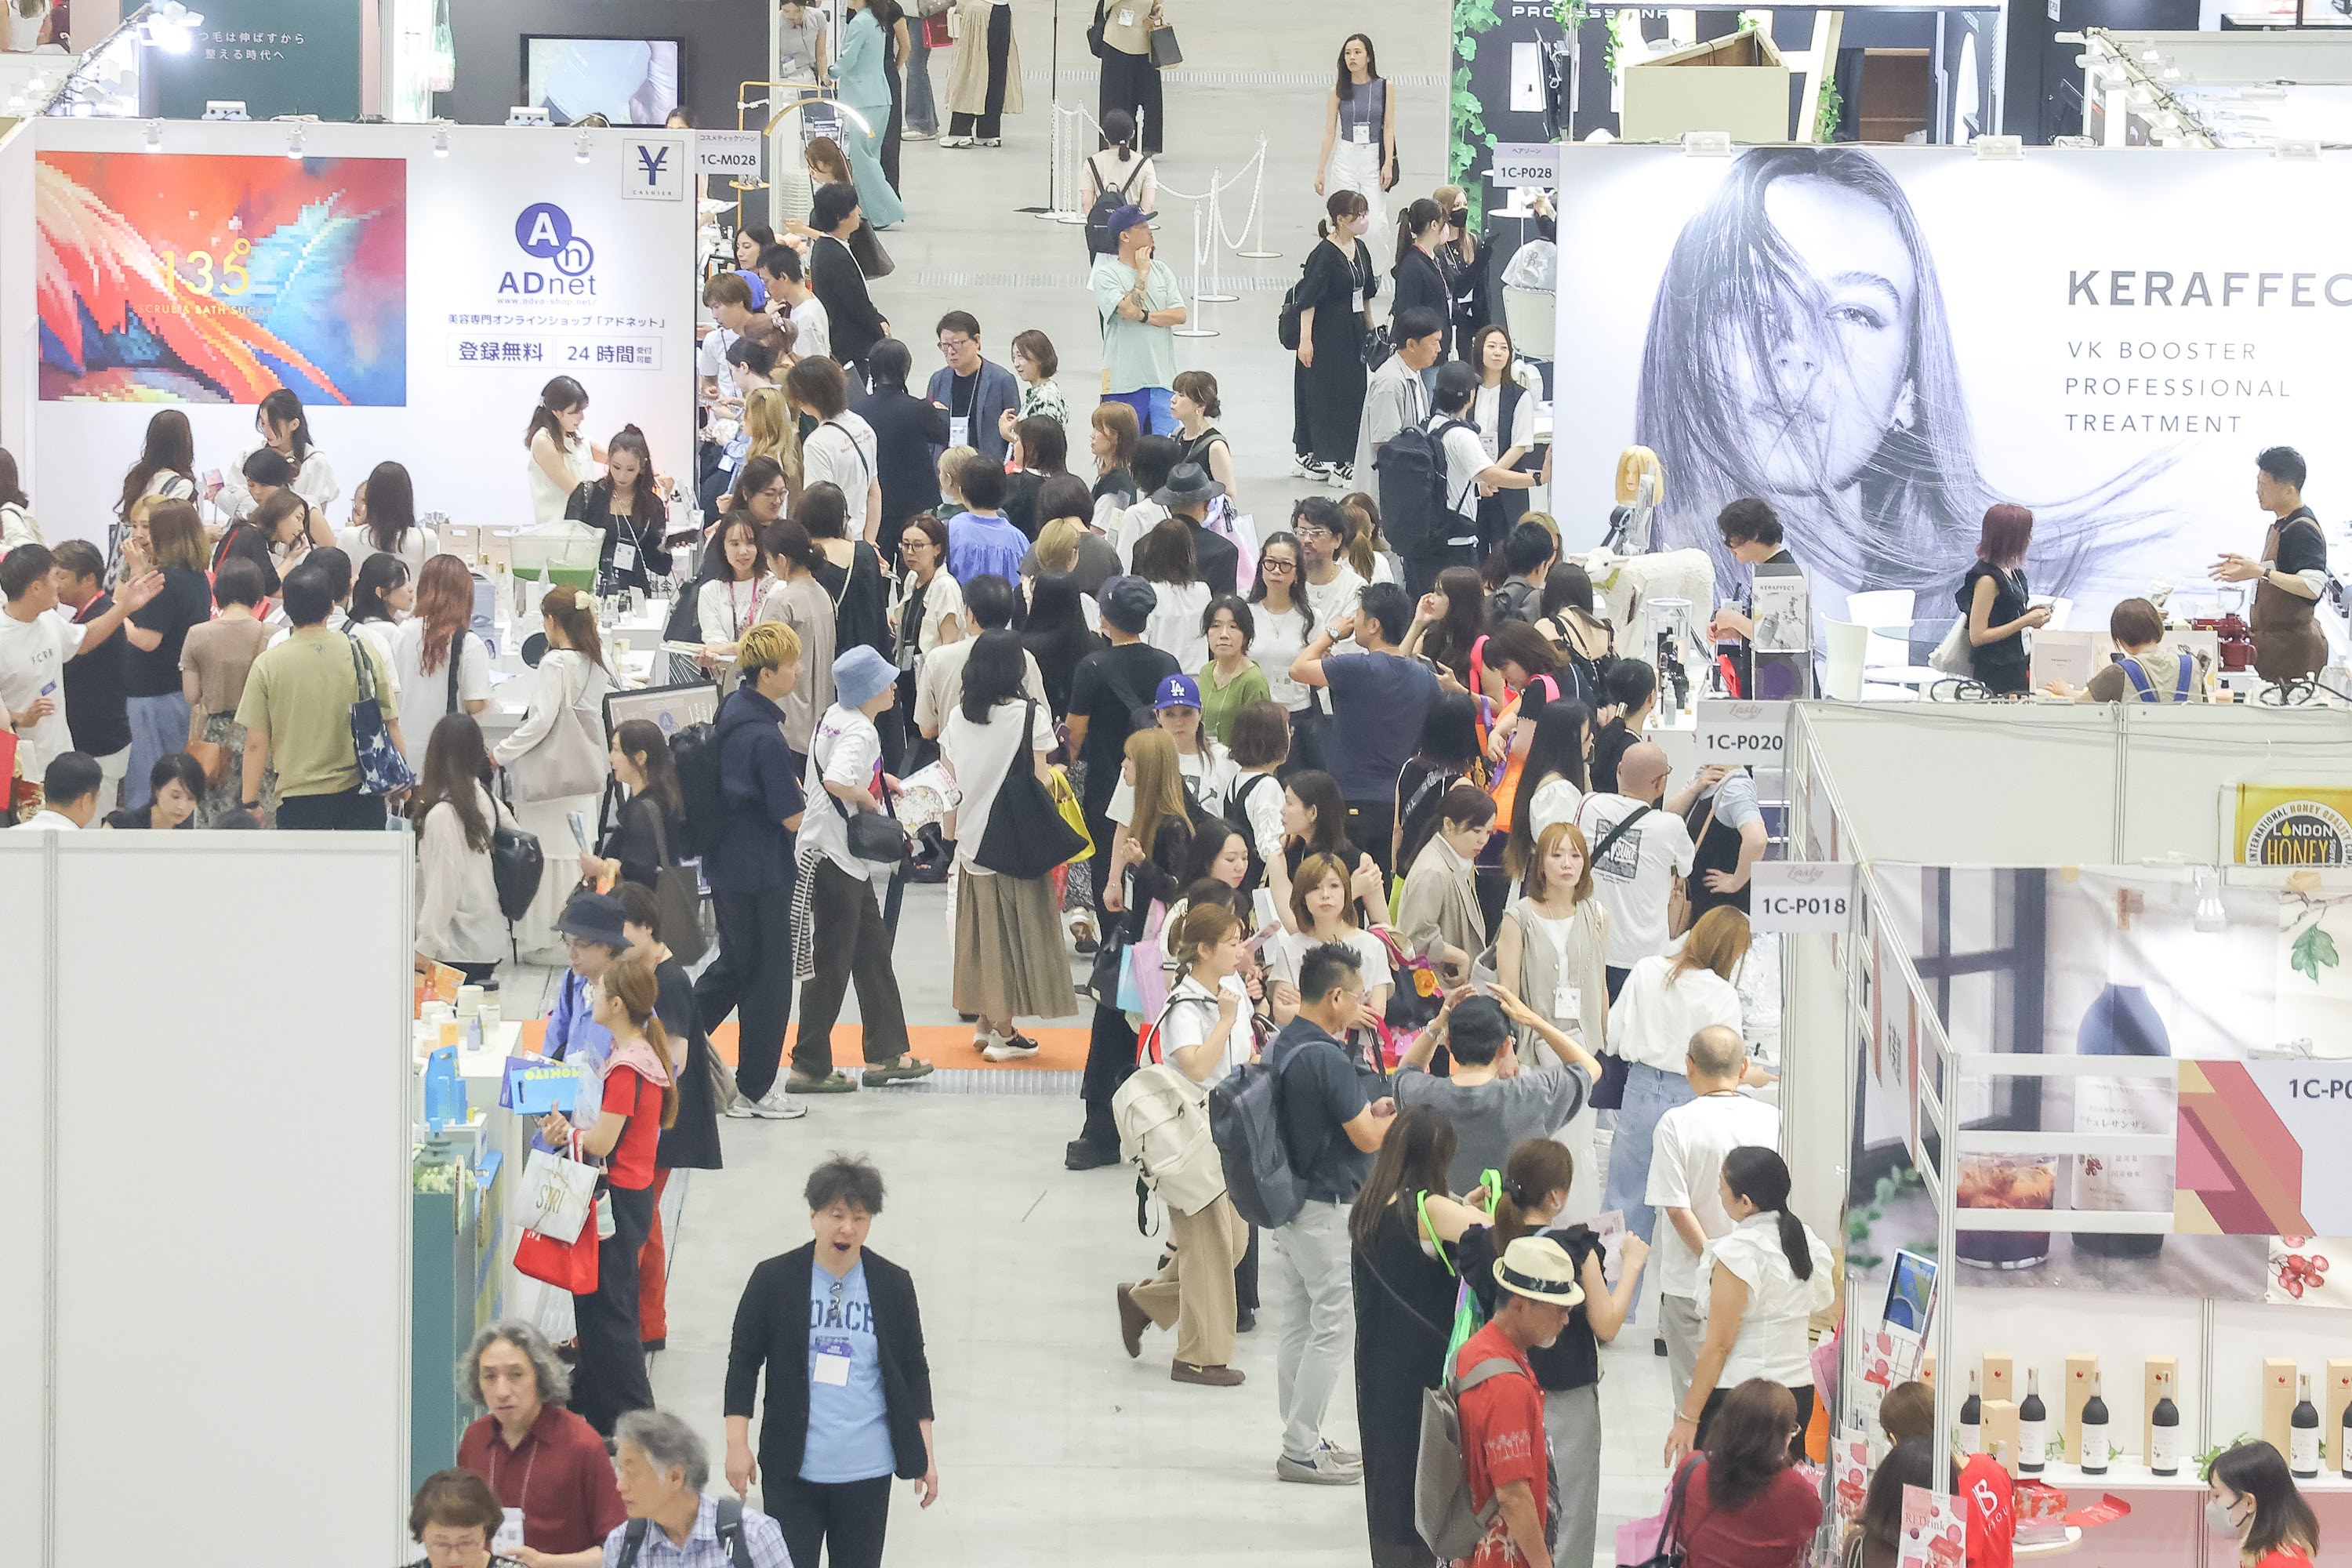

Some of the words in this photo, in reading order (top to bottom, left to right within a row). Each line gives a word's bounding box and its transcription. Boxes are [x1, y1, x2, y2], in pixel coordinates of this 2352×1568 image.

[198, 31, 305, 44] つ毛は伸ばすから
[205, 49, 285, 60] 整える時代へ
[700, 154, 757, 166] 1C-M028
[1501, 167, 1552, 179] 1C-P028
[498, 271, 597, 296] ADnet
[2068, 270, 2352, 307] KERAFFEC
[138, 303, 178, 314] SCRUB
[182, 304, 191, 314] &
[196, 304, 227, 315] BATH
[231, 305, 273, 315] SUGAR
[459, 341, 544, 362] 登録無料
[2068, 340, 2103, 359] VK
[2120, 341, 2256, 361] BOOSTER
[2065, 377, 2291, 397] PROFESSIONAL
[2064, 413, 2242, 434] TREATMENT
[1170, 679, 1185, 697] LA
[1707, 735, 1784, 750] 1C-P020
[2289, 804, 2321, 815] HONEY
[2267, 838, 2328, 866] HONEY
[1762, 898, 1846, 916] 1C-P018
